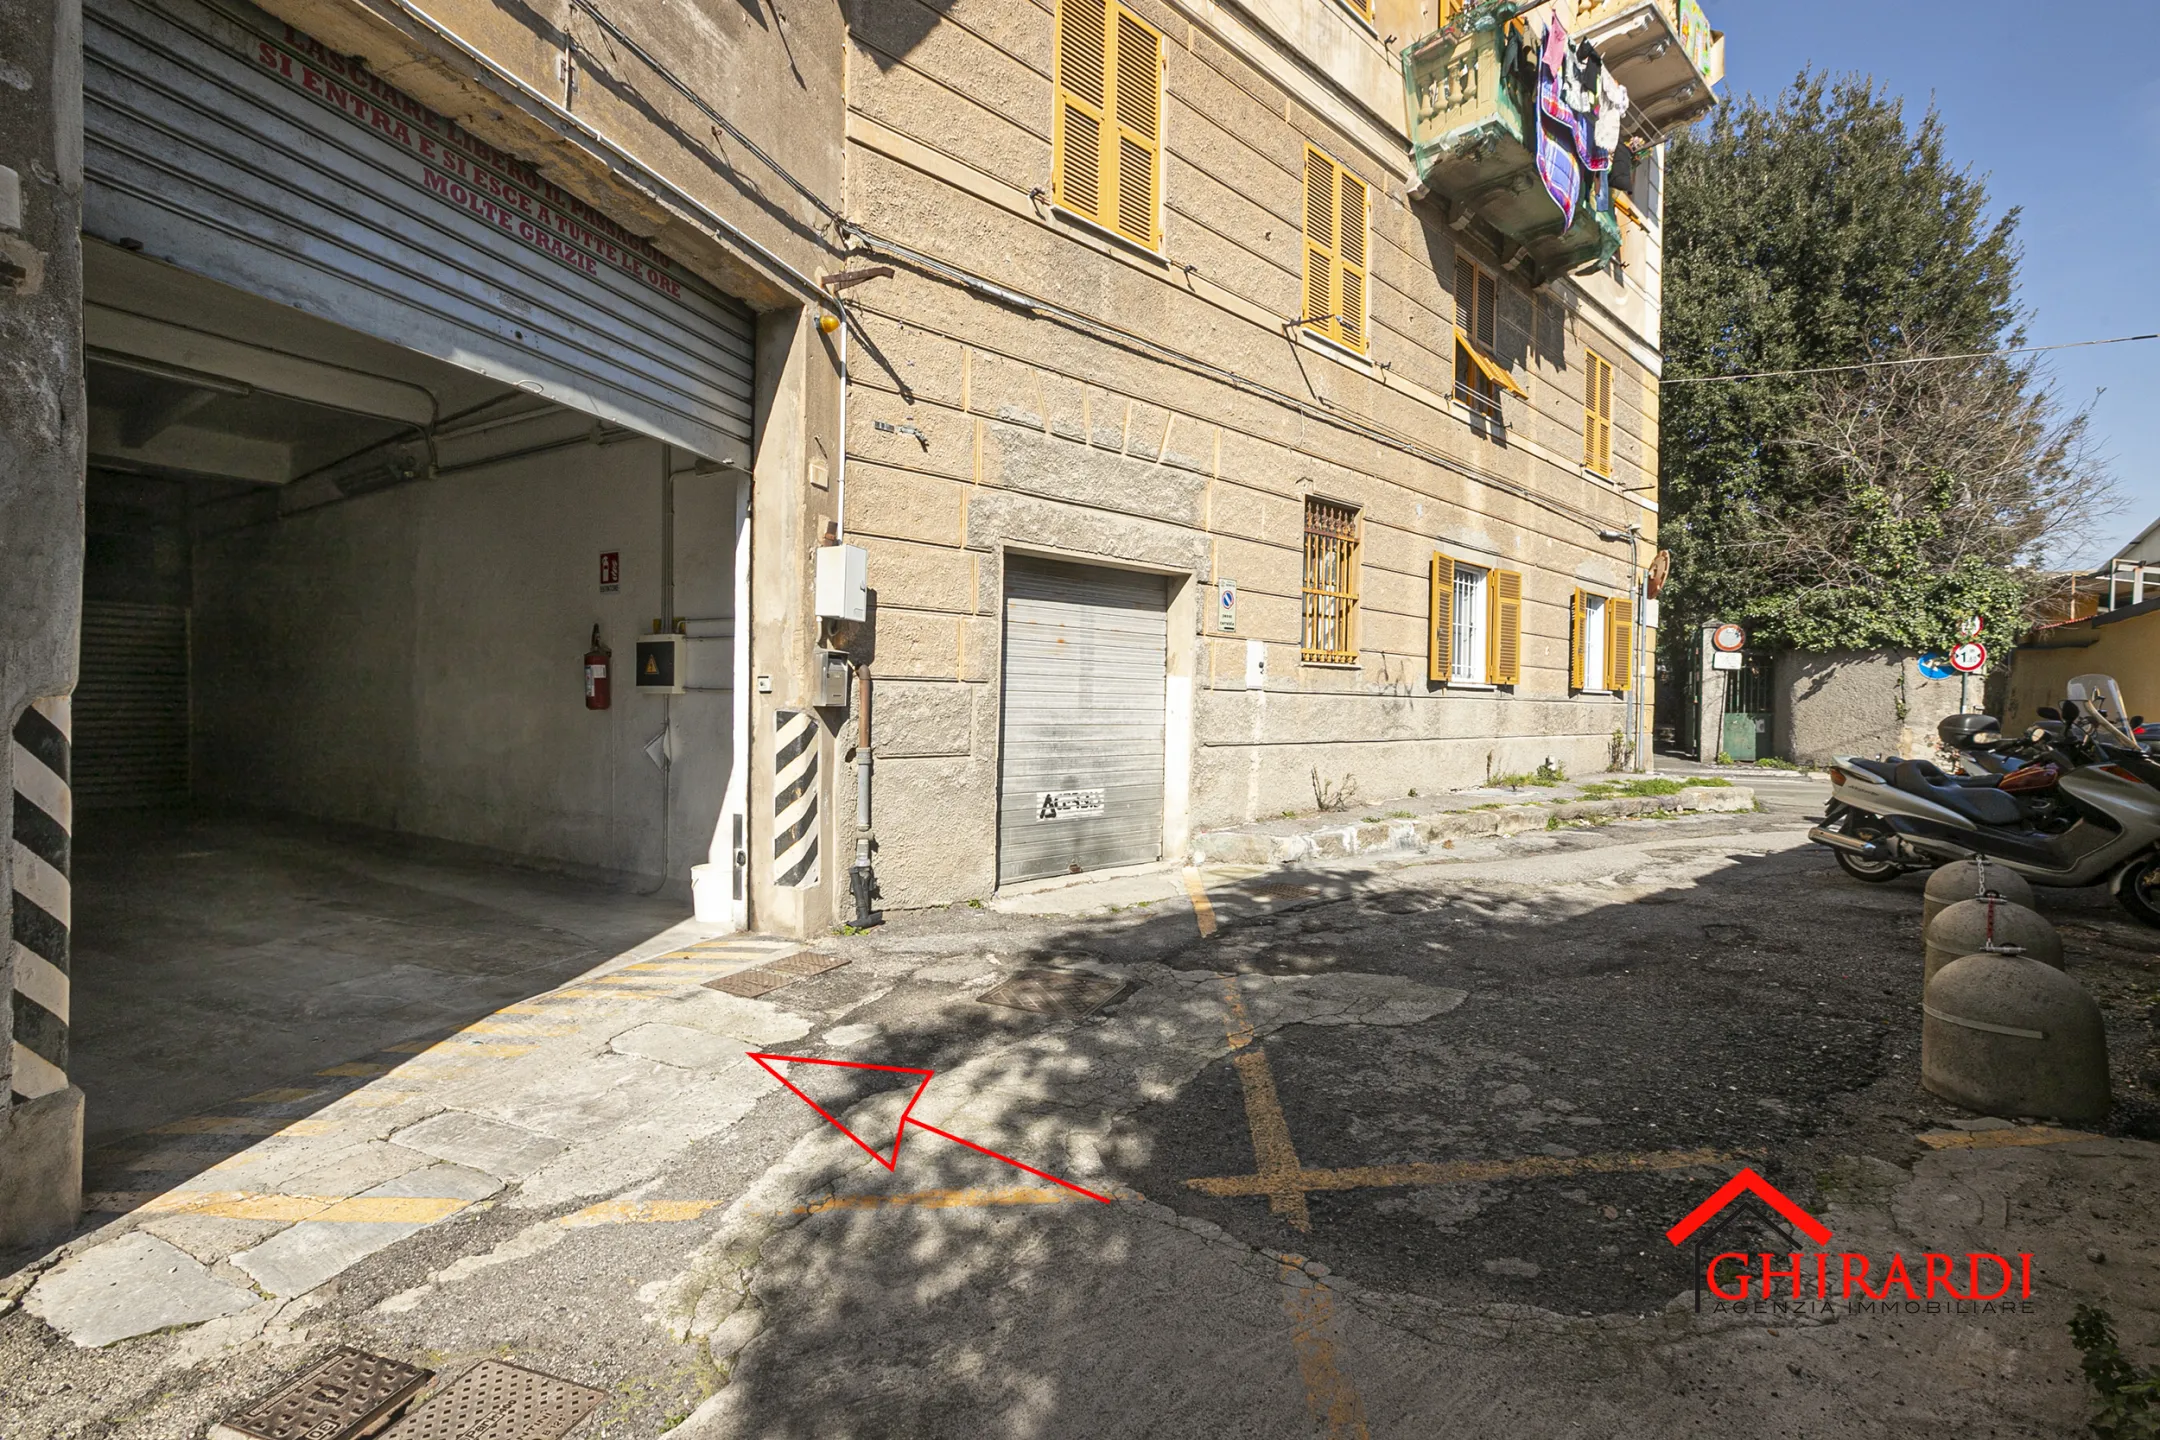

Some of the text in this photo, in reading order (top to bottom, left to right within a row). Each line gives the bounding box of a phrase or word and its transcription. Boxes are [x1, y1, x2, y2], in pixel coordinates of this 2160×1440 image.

[259, 42, 681, 299] SI ENTRA E SI ESCE A TUTTE LE ORE
[284, 24, 439, 133] LASCIARE
[447, 122, 539, 191] LIBERO
[544, 181, 566, 209] IL
[423, 166, 597, 276] MOLTE GRAZIE
[463, 1413, 499, 1440] Park
